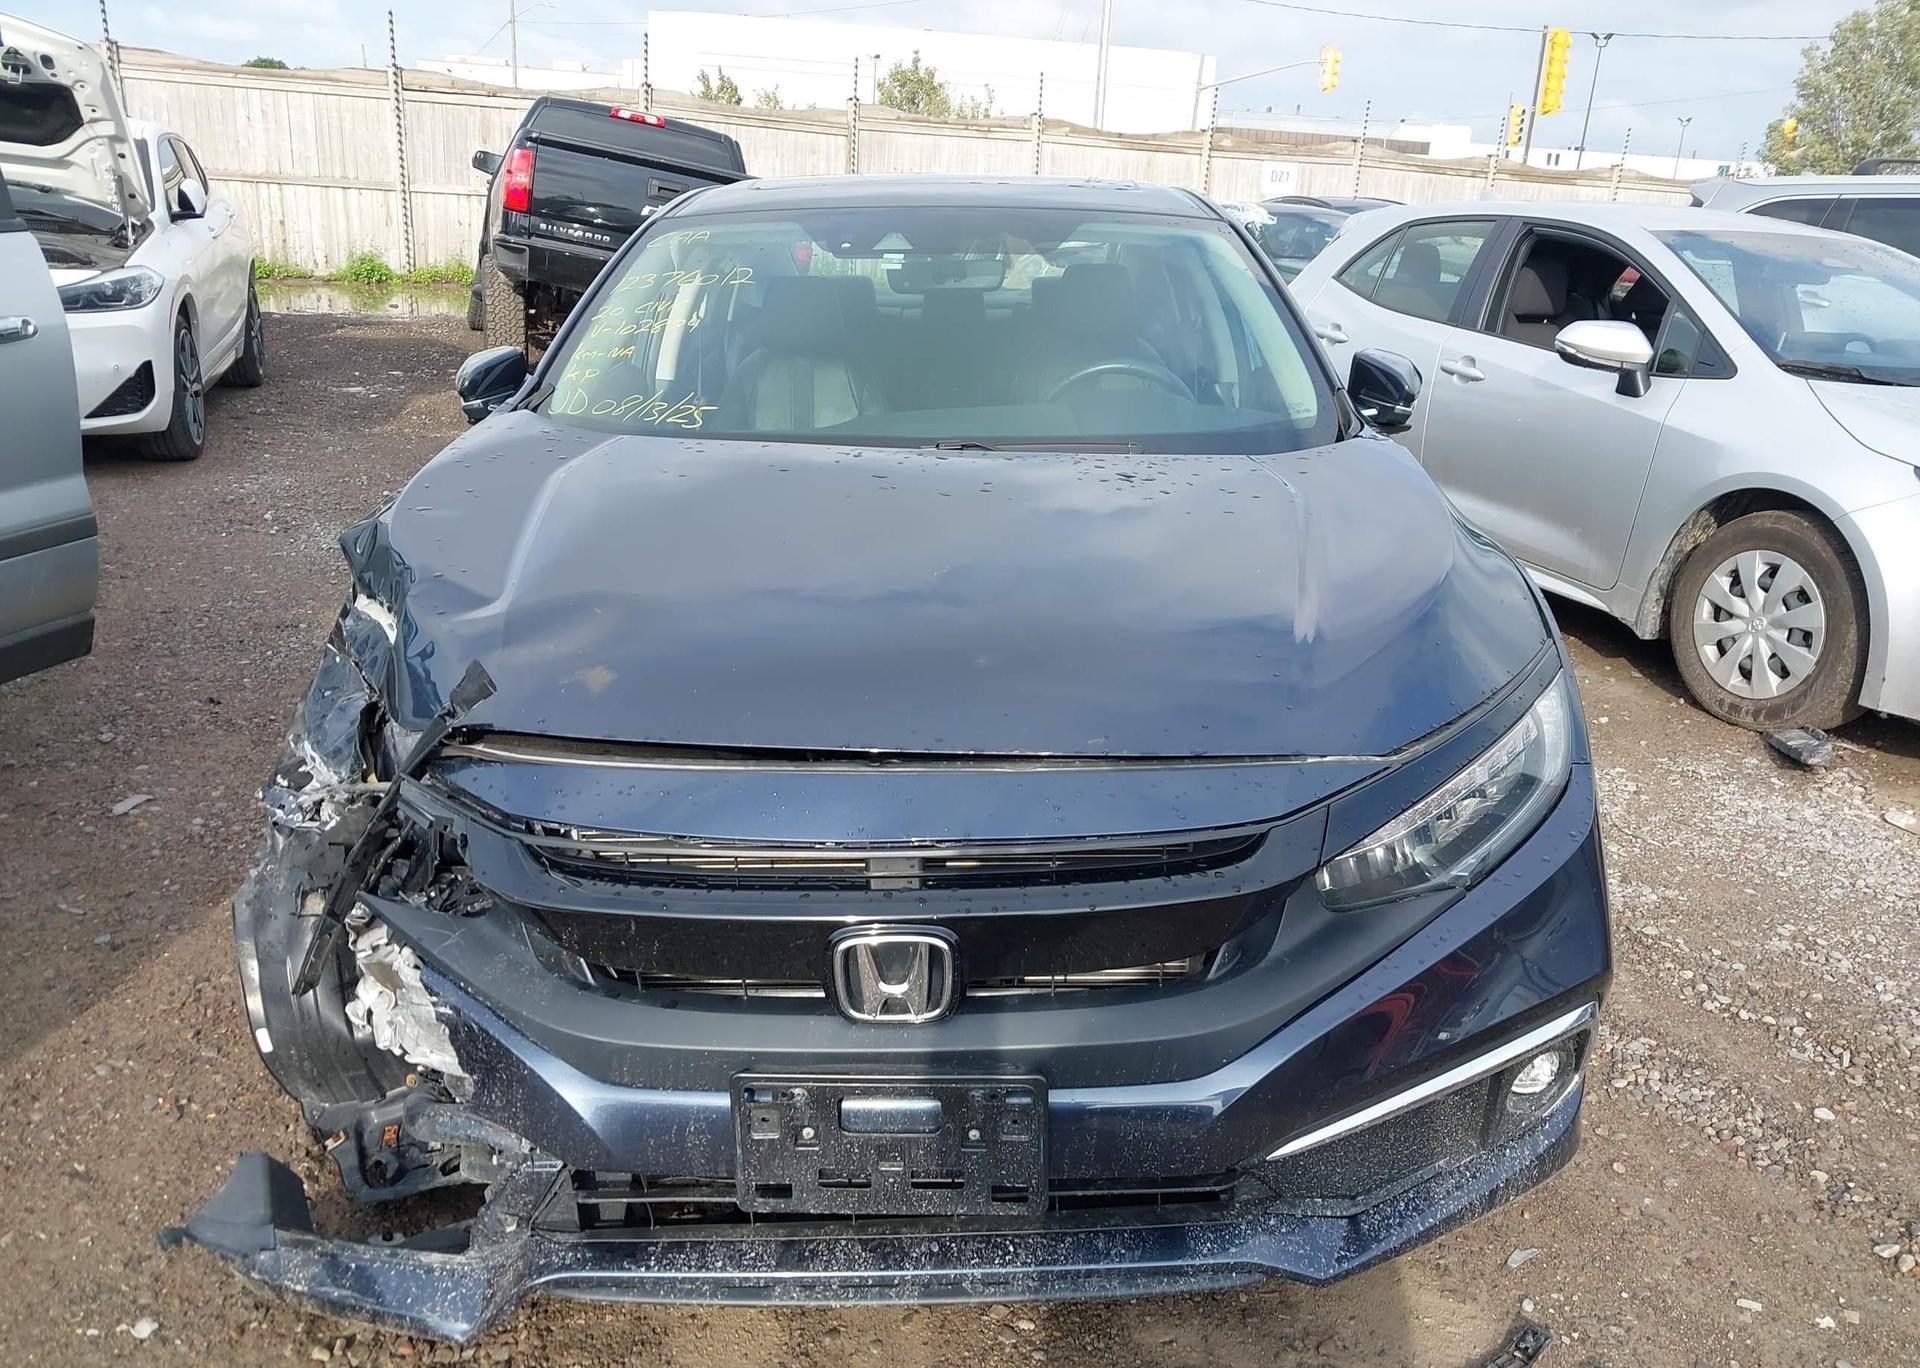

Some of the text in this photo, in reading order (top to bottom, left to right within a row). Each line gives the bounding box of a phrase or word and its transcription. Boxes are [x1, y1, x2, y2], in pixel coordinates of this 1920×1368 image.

[540, 223, 610, 242] SILVERADO
[647, 231, 710, 247] CAA
[591, 305, 624, 321] 20
[592, 390, 719, 429] 08/13/25
